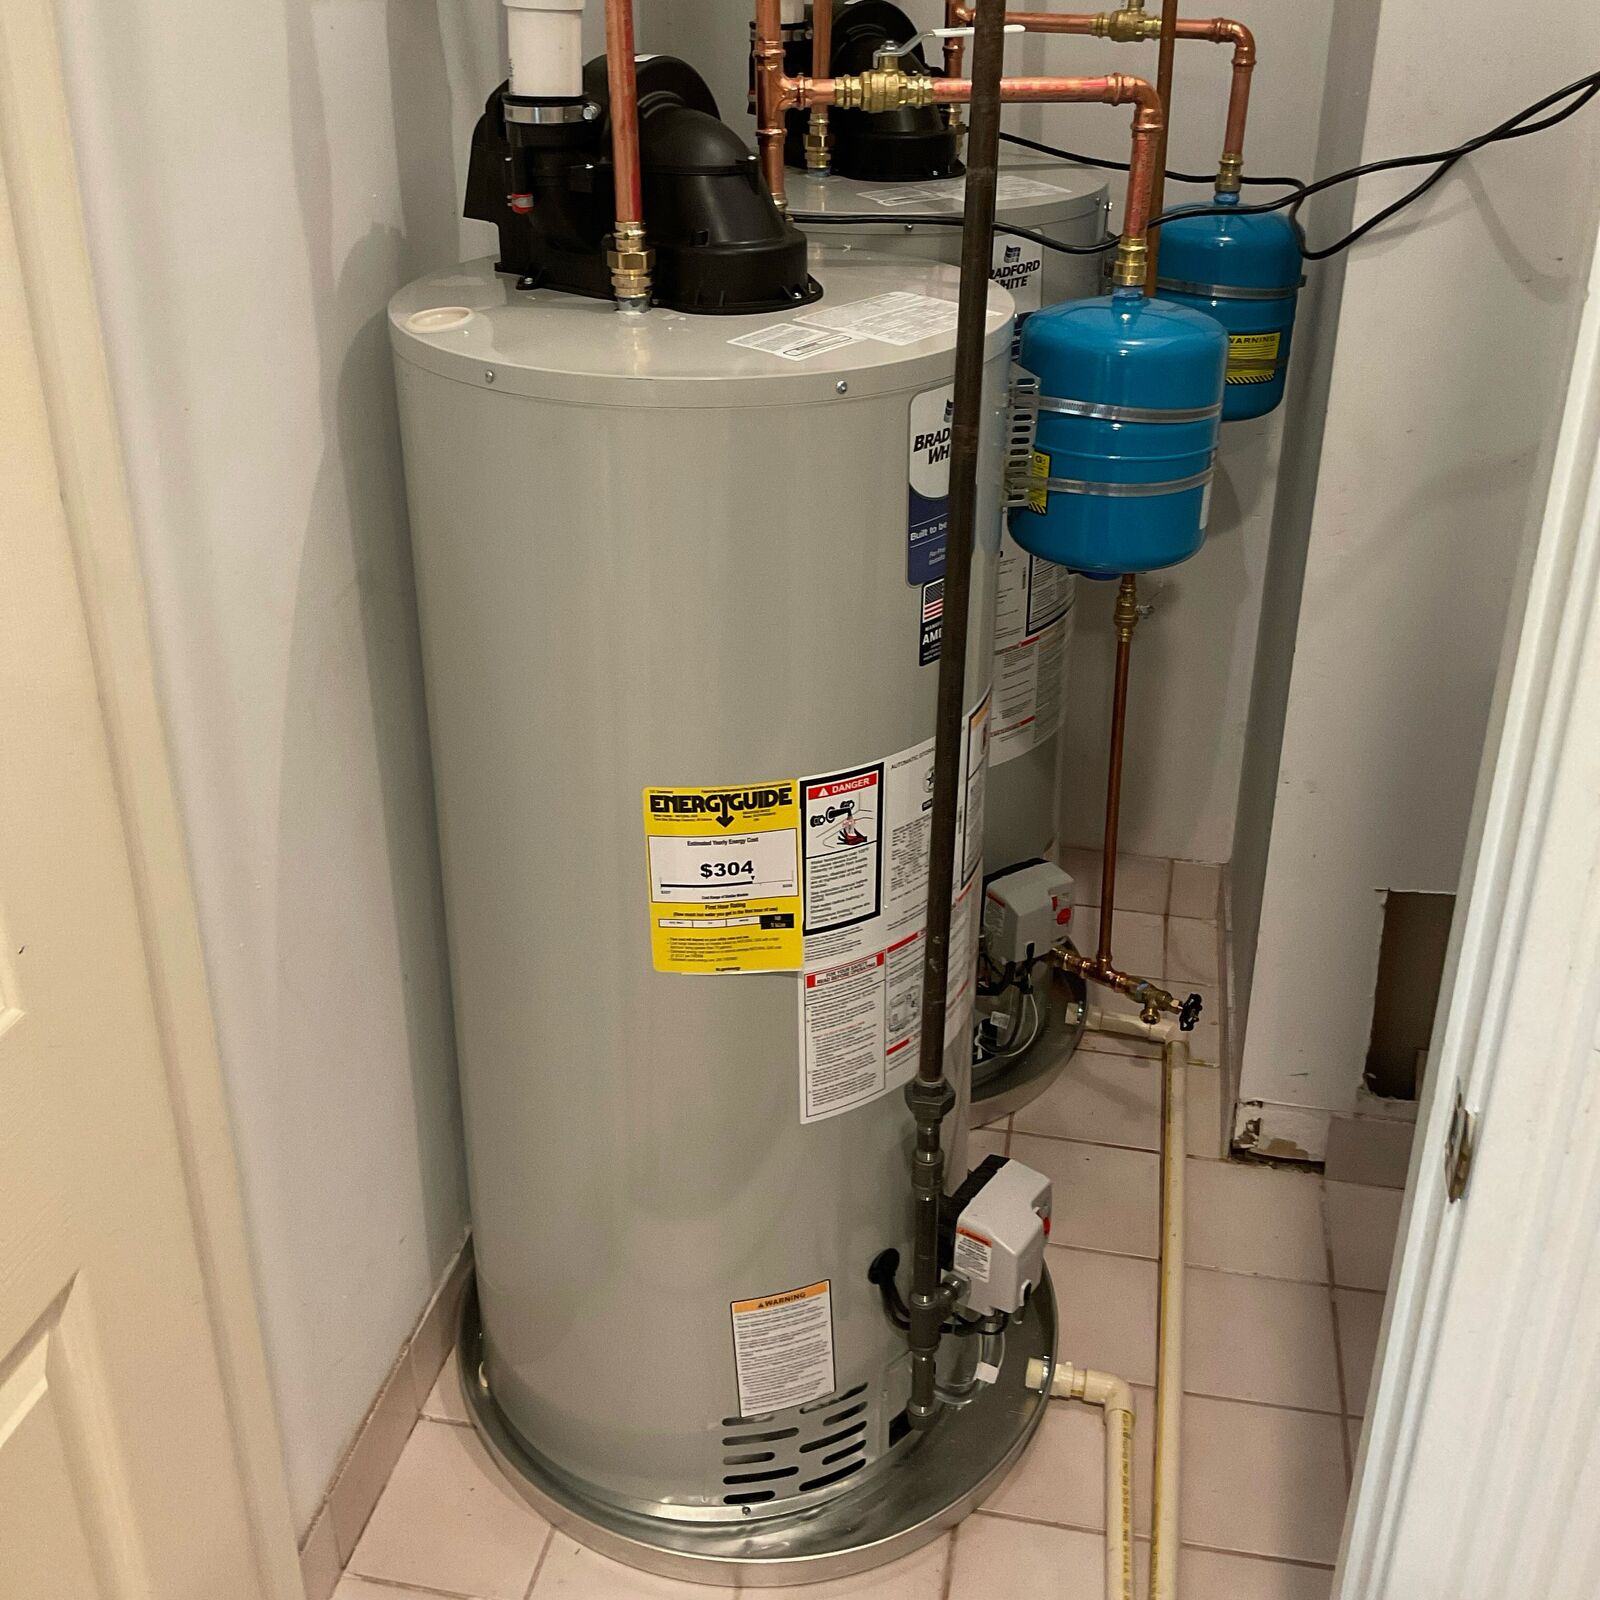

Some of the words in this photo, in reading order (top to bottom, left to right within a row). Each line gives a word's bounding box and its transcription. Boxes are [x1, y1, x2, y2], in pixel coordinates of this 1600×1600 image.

[832, 777, 870, 794] DANGER
[650, 787, 793, 826] ENERGYGUIDE
[700, 860, 754, 879] $304
[765, 1292, 806, 1307] WARNING
